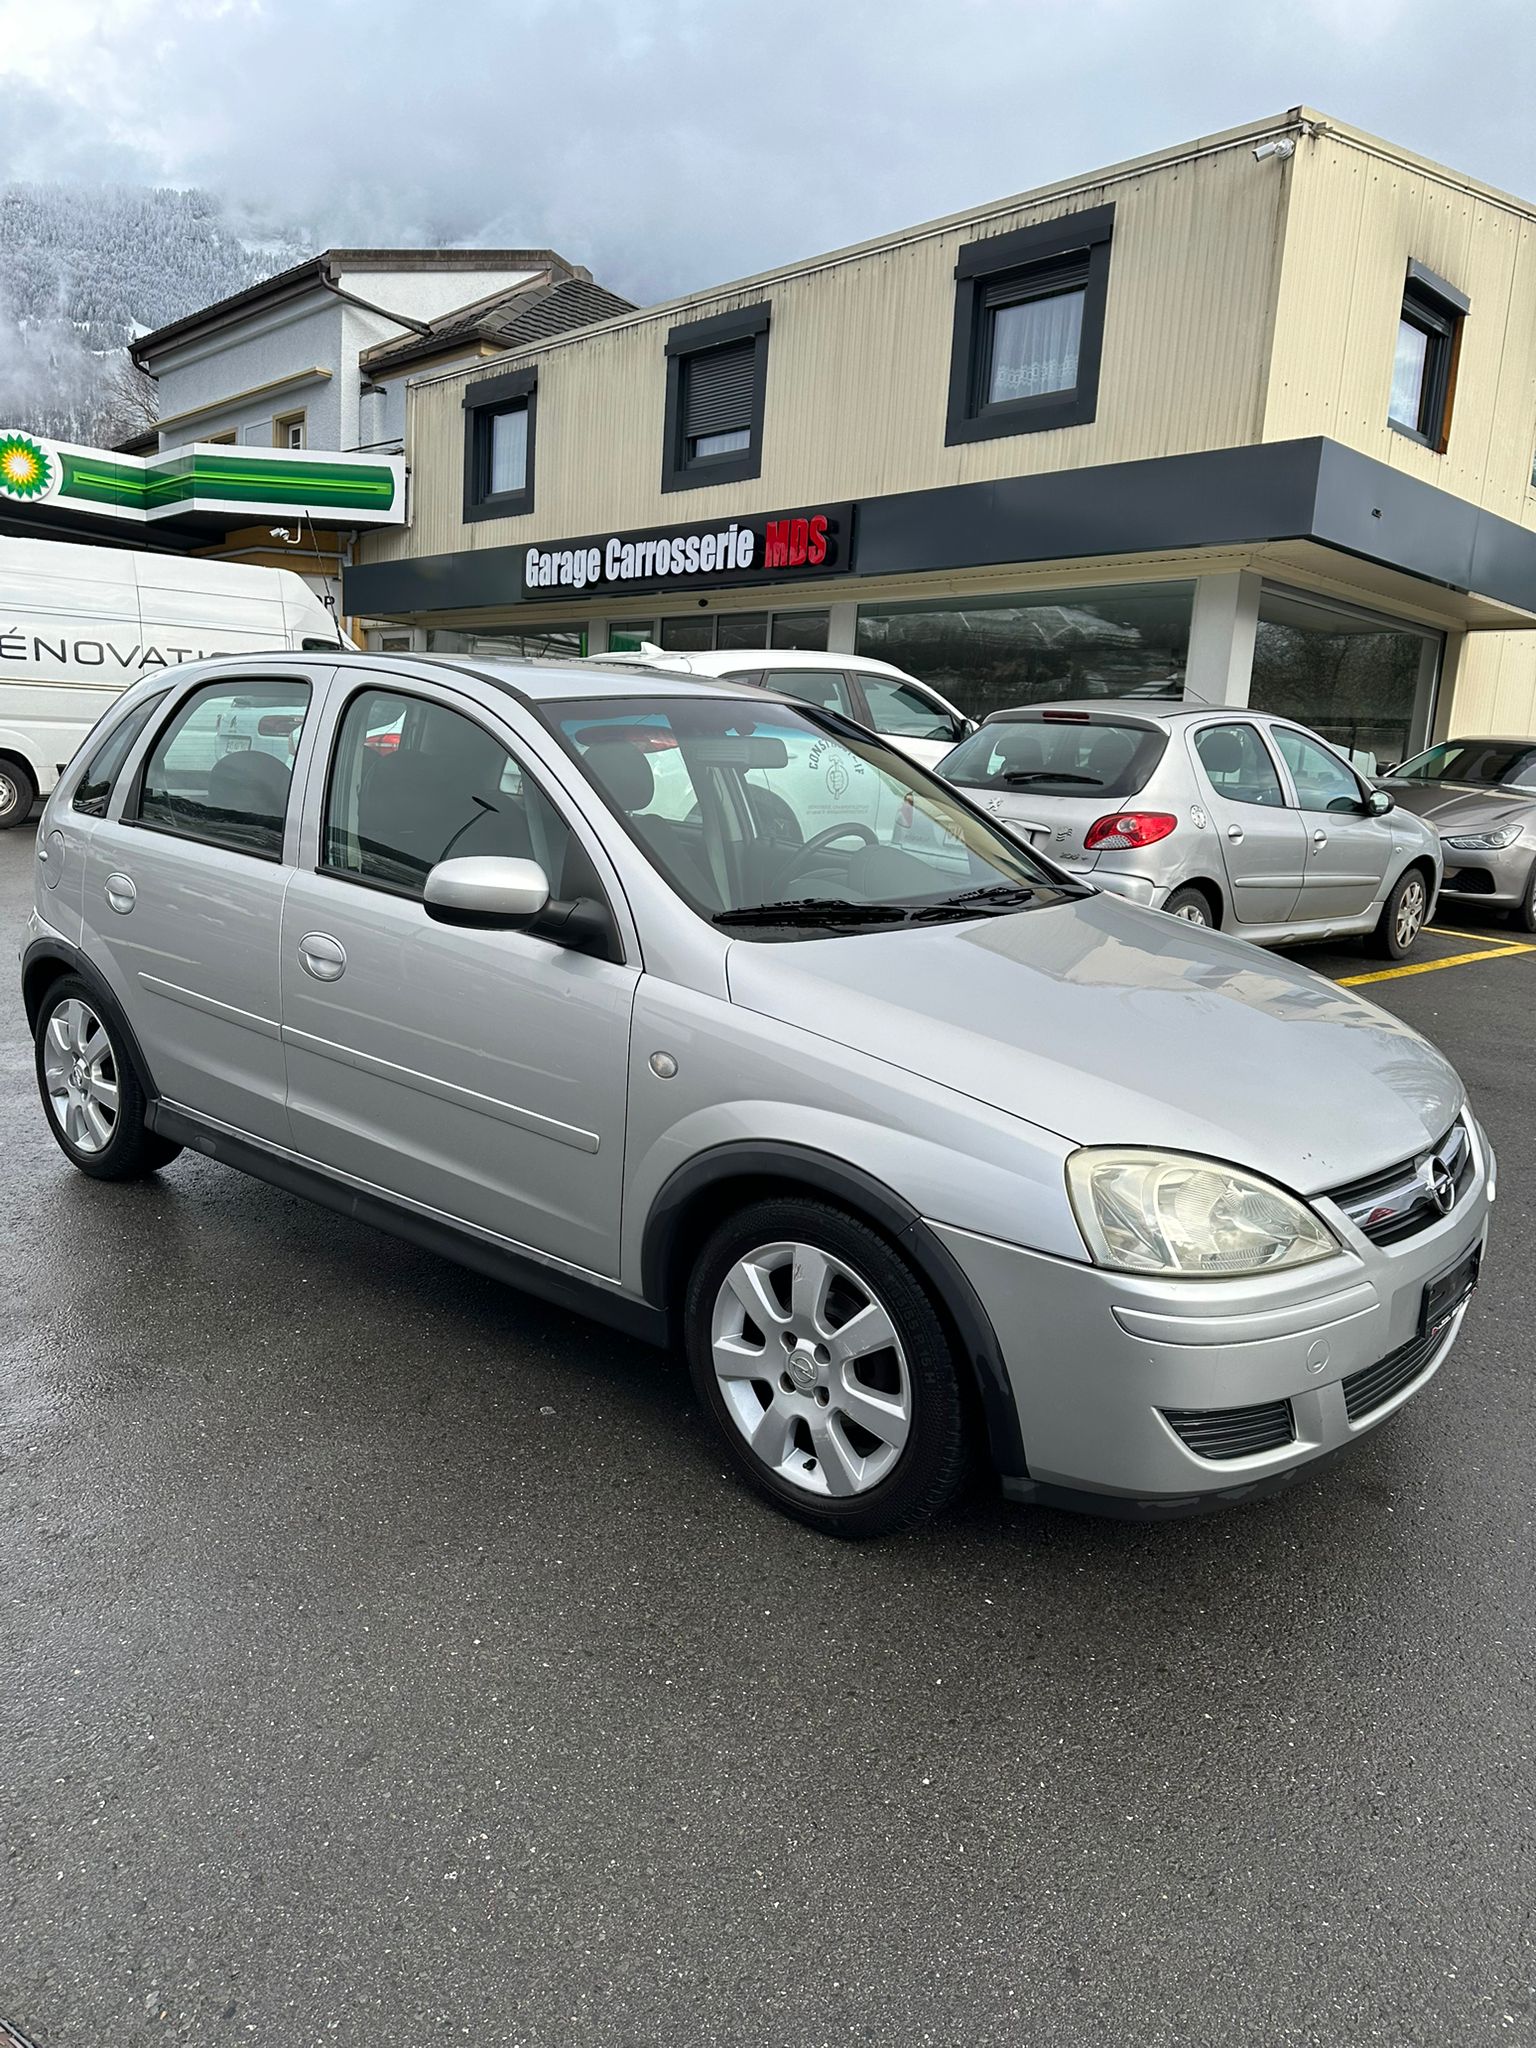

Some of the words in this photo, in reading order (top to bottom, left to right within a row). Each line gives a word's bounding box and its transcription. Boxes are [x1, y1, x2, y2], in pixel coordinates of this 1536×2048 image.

[525, 548, 600, 588] Garage
[605, 524, 754, 581] Carrosserie
[764, 515, 828, 568] MDS
[316, 594, 335, 609] P
[0, 627, 232, 669] ÉNOVAT
